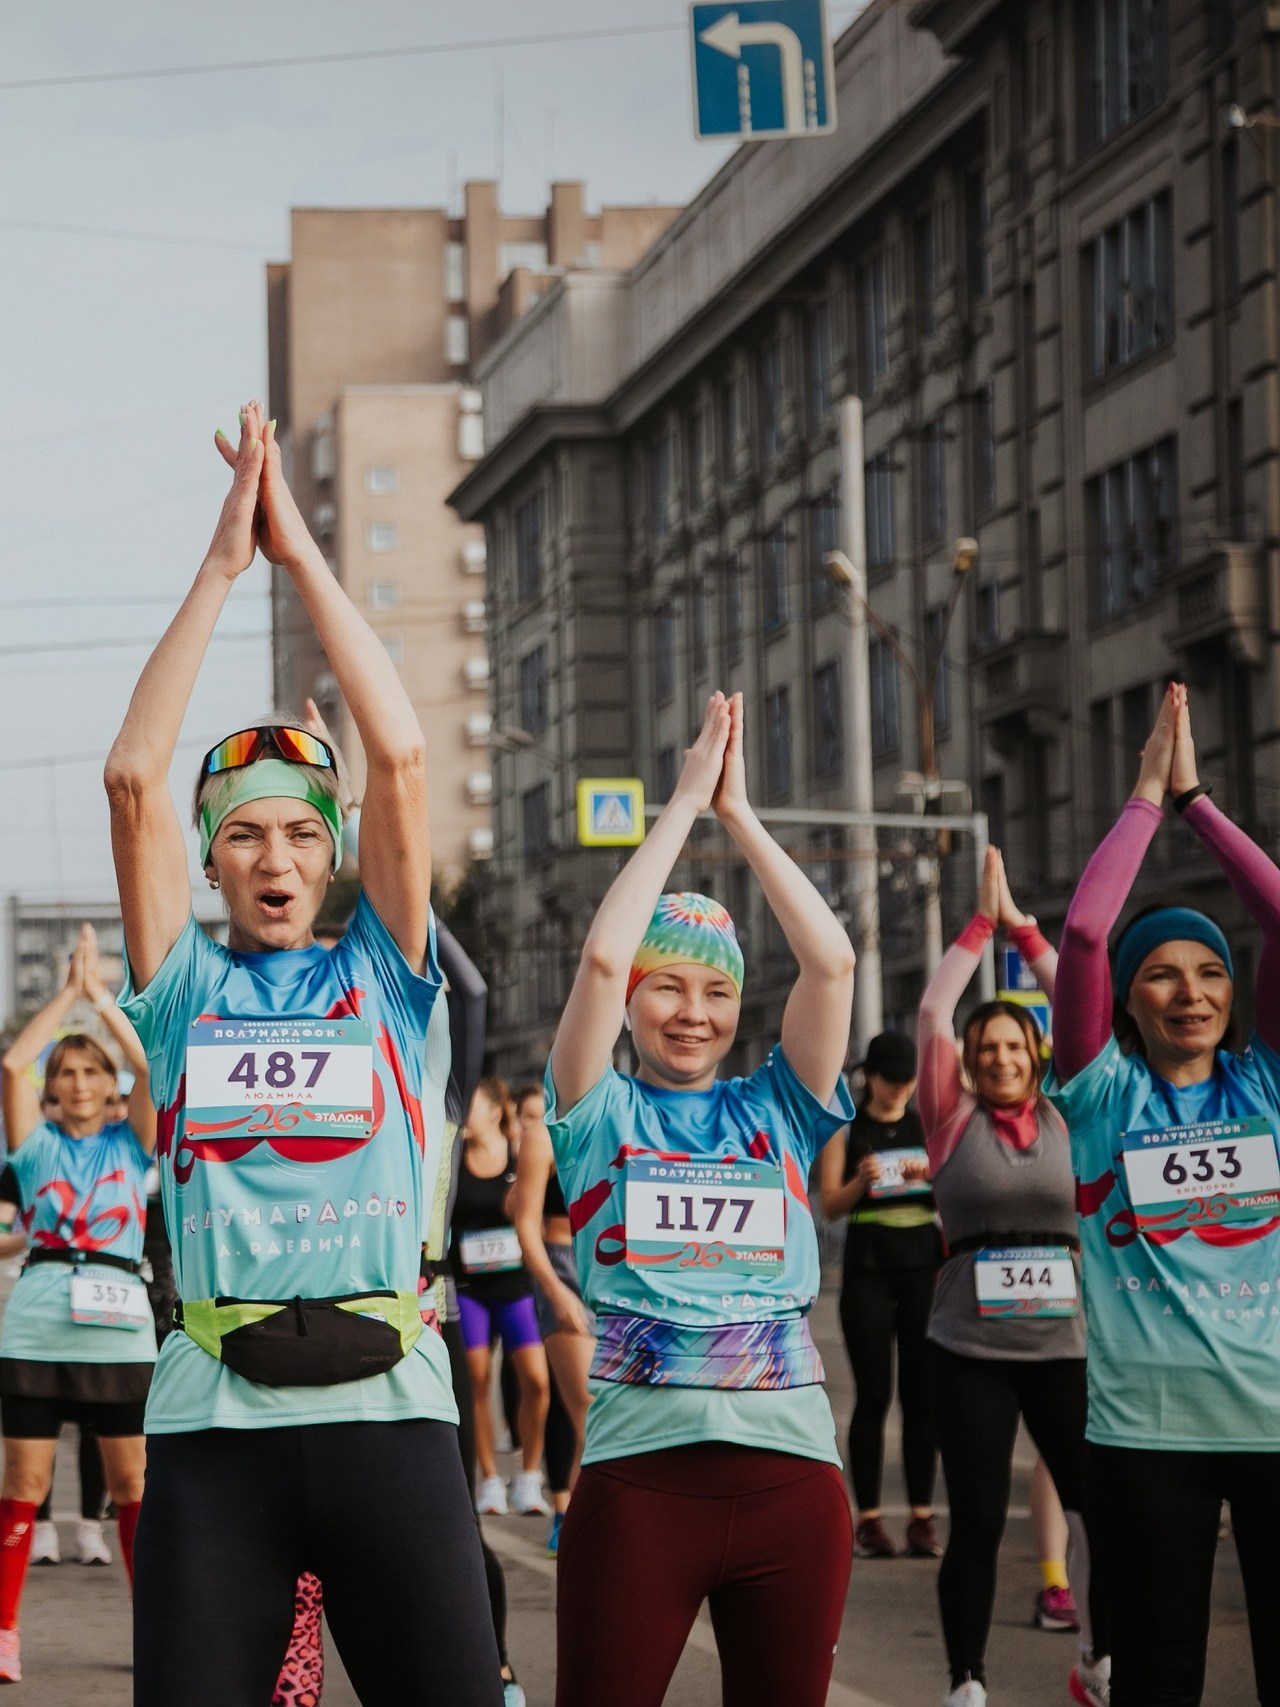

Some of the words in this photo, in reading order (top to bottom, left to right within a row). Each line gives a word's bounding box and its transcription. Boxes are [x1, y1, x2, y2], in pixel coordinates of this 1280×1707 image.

[214, 1028, 335, 1038] ПОЛУМАРАФОН
[227, 1051, 331, 1089] 487
[244, 1092, 313, 1100] ЛЮДМИЛА
[247, 1101, 304, 1133] 26
[315, 1112, 365, 1123] ЭТАЛОН
[649, 1167, 752, 1181] ПОЛУМАРАФОН
[1162, 1146, 1243, 1185] 633
[1187, 1191, 1227, 1222] 26
[1238, 1195, 1279, 1208] ЭТАЛОН
[656, 1194, 755, 1234] 1177
[251, 1233, 361, 1257] РАЕВИЧА
[679, 1240, 726, 1269] 26
[735, 1250, 778, 1262] ЭТАЛОН
[1001, 1267, 1052, 1287] 344
[93, 1284, 130, 1305] 357
